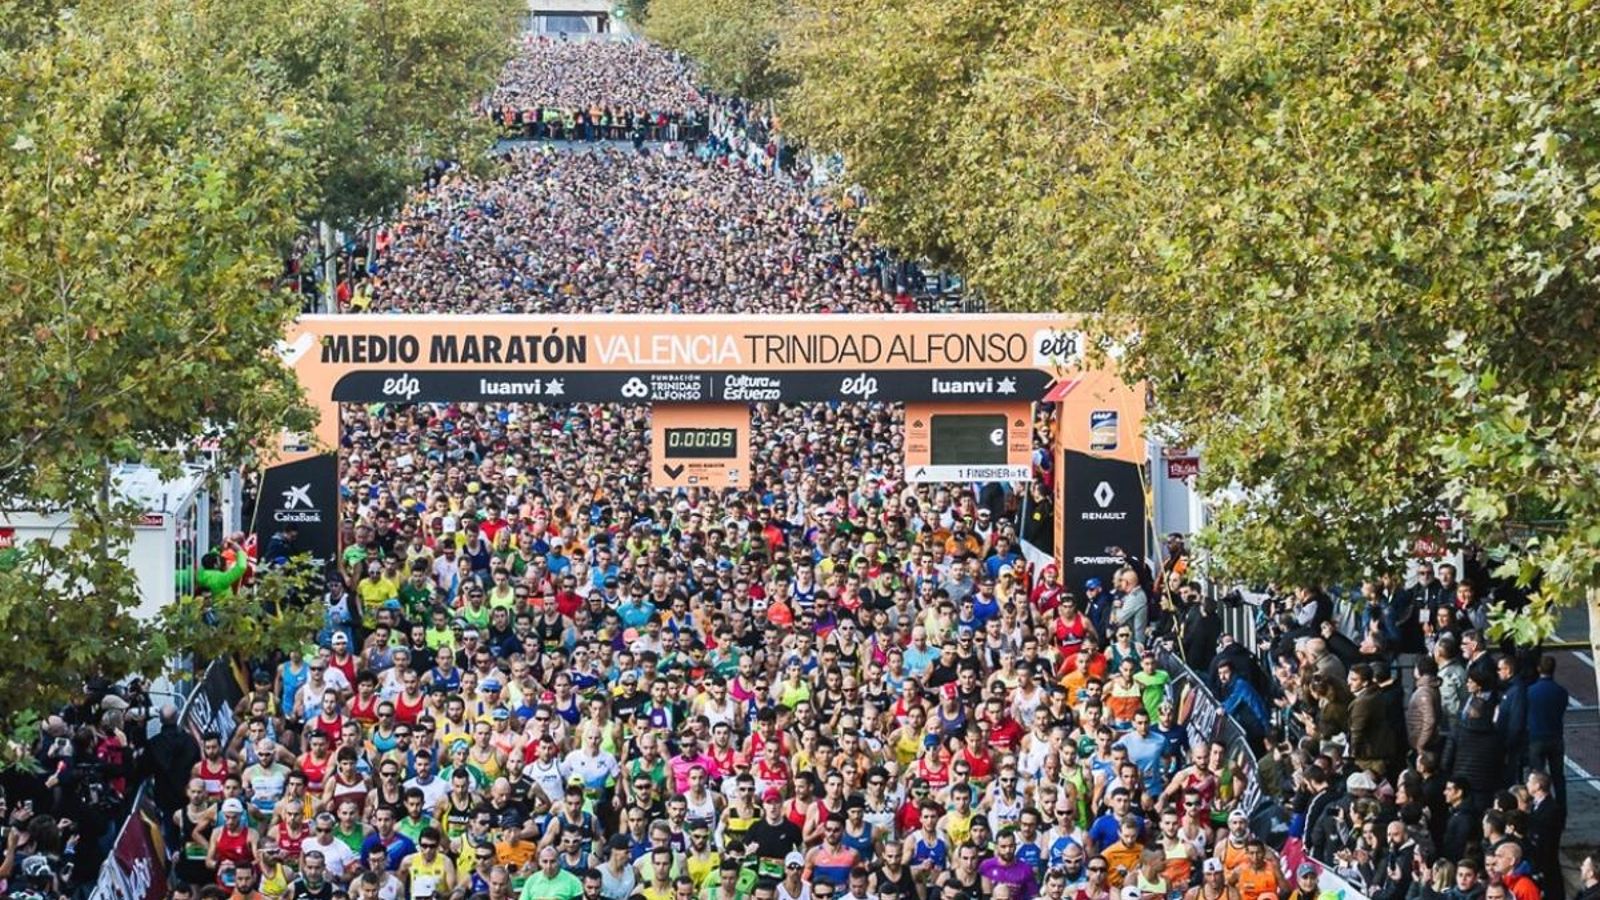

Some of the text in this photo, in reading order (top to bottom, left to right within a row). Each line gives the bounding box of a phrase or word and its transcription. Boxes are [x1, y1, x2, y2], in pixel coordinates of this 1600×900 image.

[321, 327, 1027, 364] MEDIO MARATÓN VALENCIA TRINIDAD ALFONSO
[1040, 332, 1077, 363] edp
[382, 373, 420, 400] edp
[480, 379, 541, 395] luanvi
[651, 382, 701, 391] TRINIDAD
[725, 374, 769, 387] Cultura
[840, 373, 877, 399] edp
[932, 378, 993, 393] luanvi
[651, 391, 701, 400] ALFONSO
[723, 387, 781, 400] Esfuerzo
[990, 428, 1004, 446] €
[273, 512, 321, 522] CaixaBank
[1082, 512, 1127, 520] RENAULT
[1074, 556, 1124, 565] POWERAD
